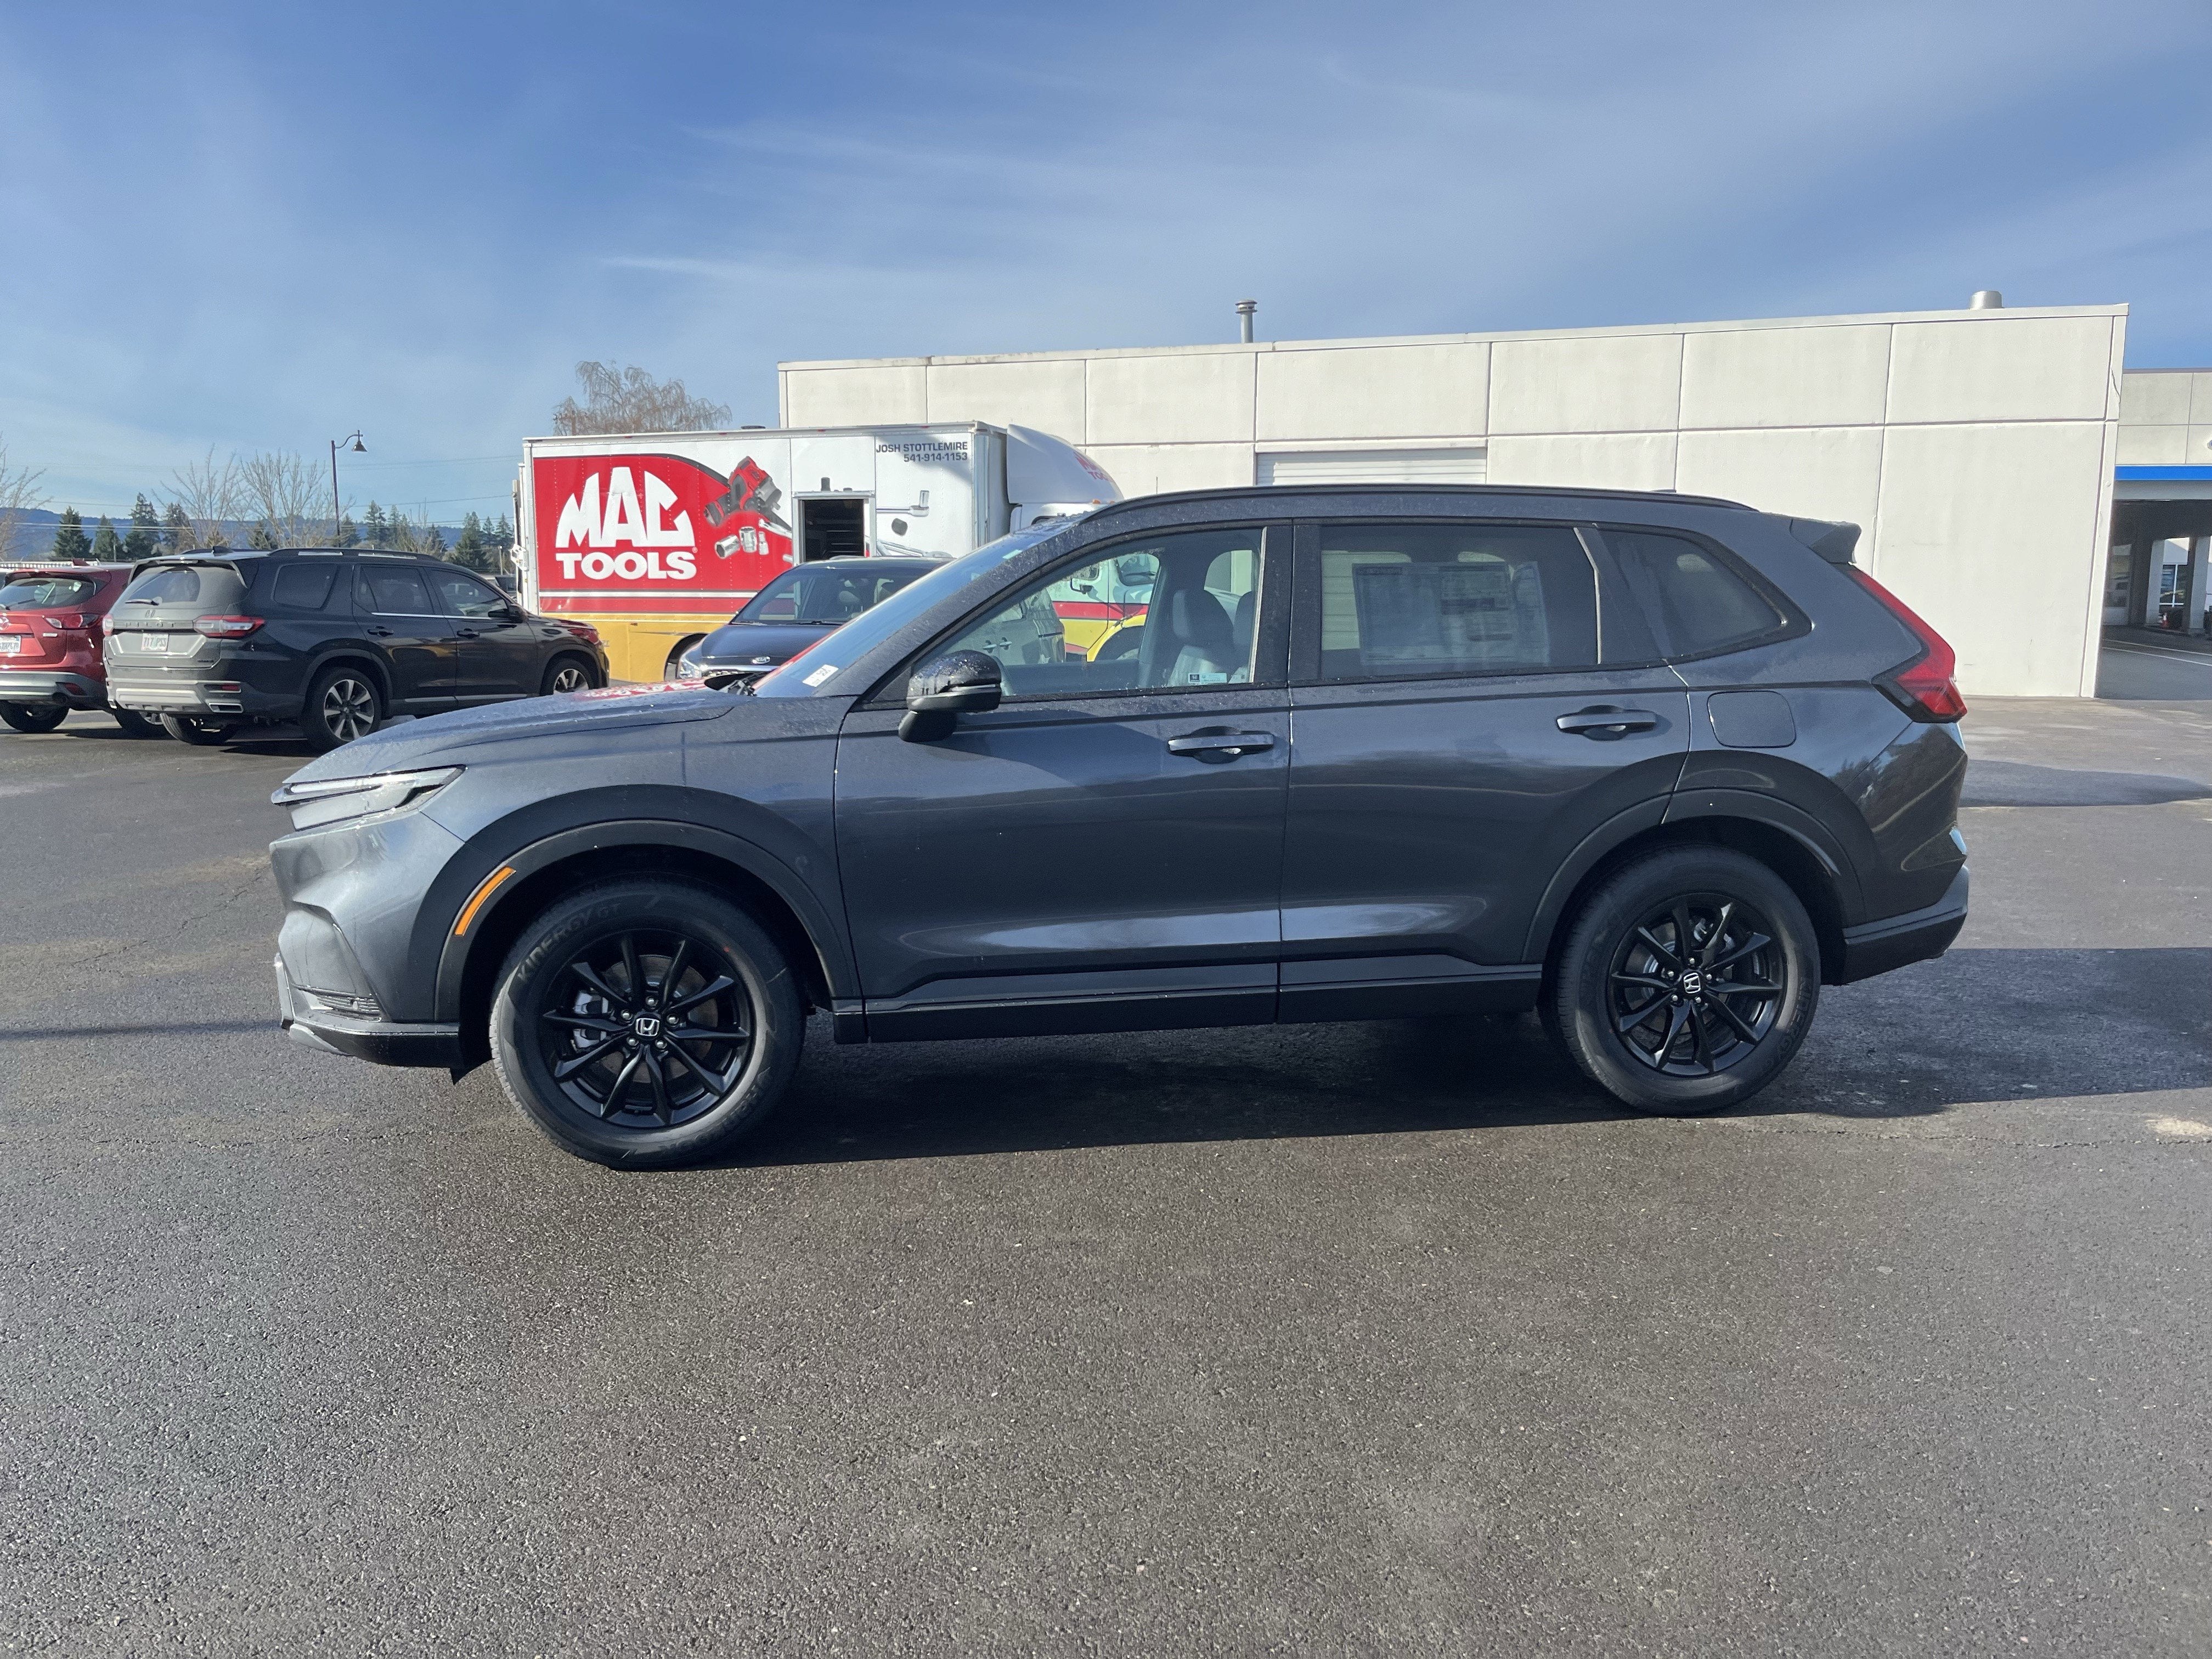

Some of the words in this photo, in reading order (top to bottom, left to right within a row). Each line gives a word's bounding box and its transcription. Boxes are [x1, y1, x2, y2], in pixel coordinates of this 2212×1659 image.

[904, 442, 968, 452] STOTTLEMIRE
[904, 452, 968, 462] 541-914-1153
[555, 466, 696, 548] MAC
[555, 551, 697, 580] TOOLS
